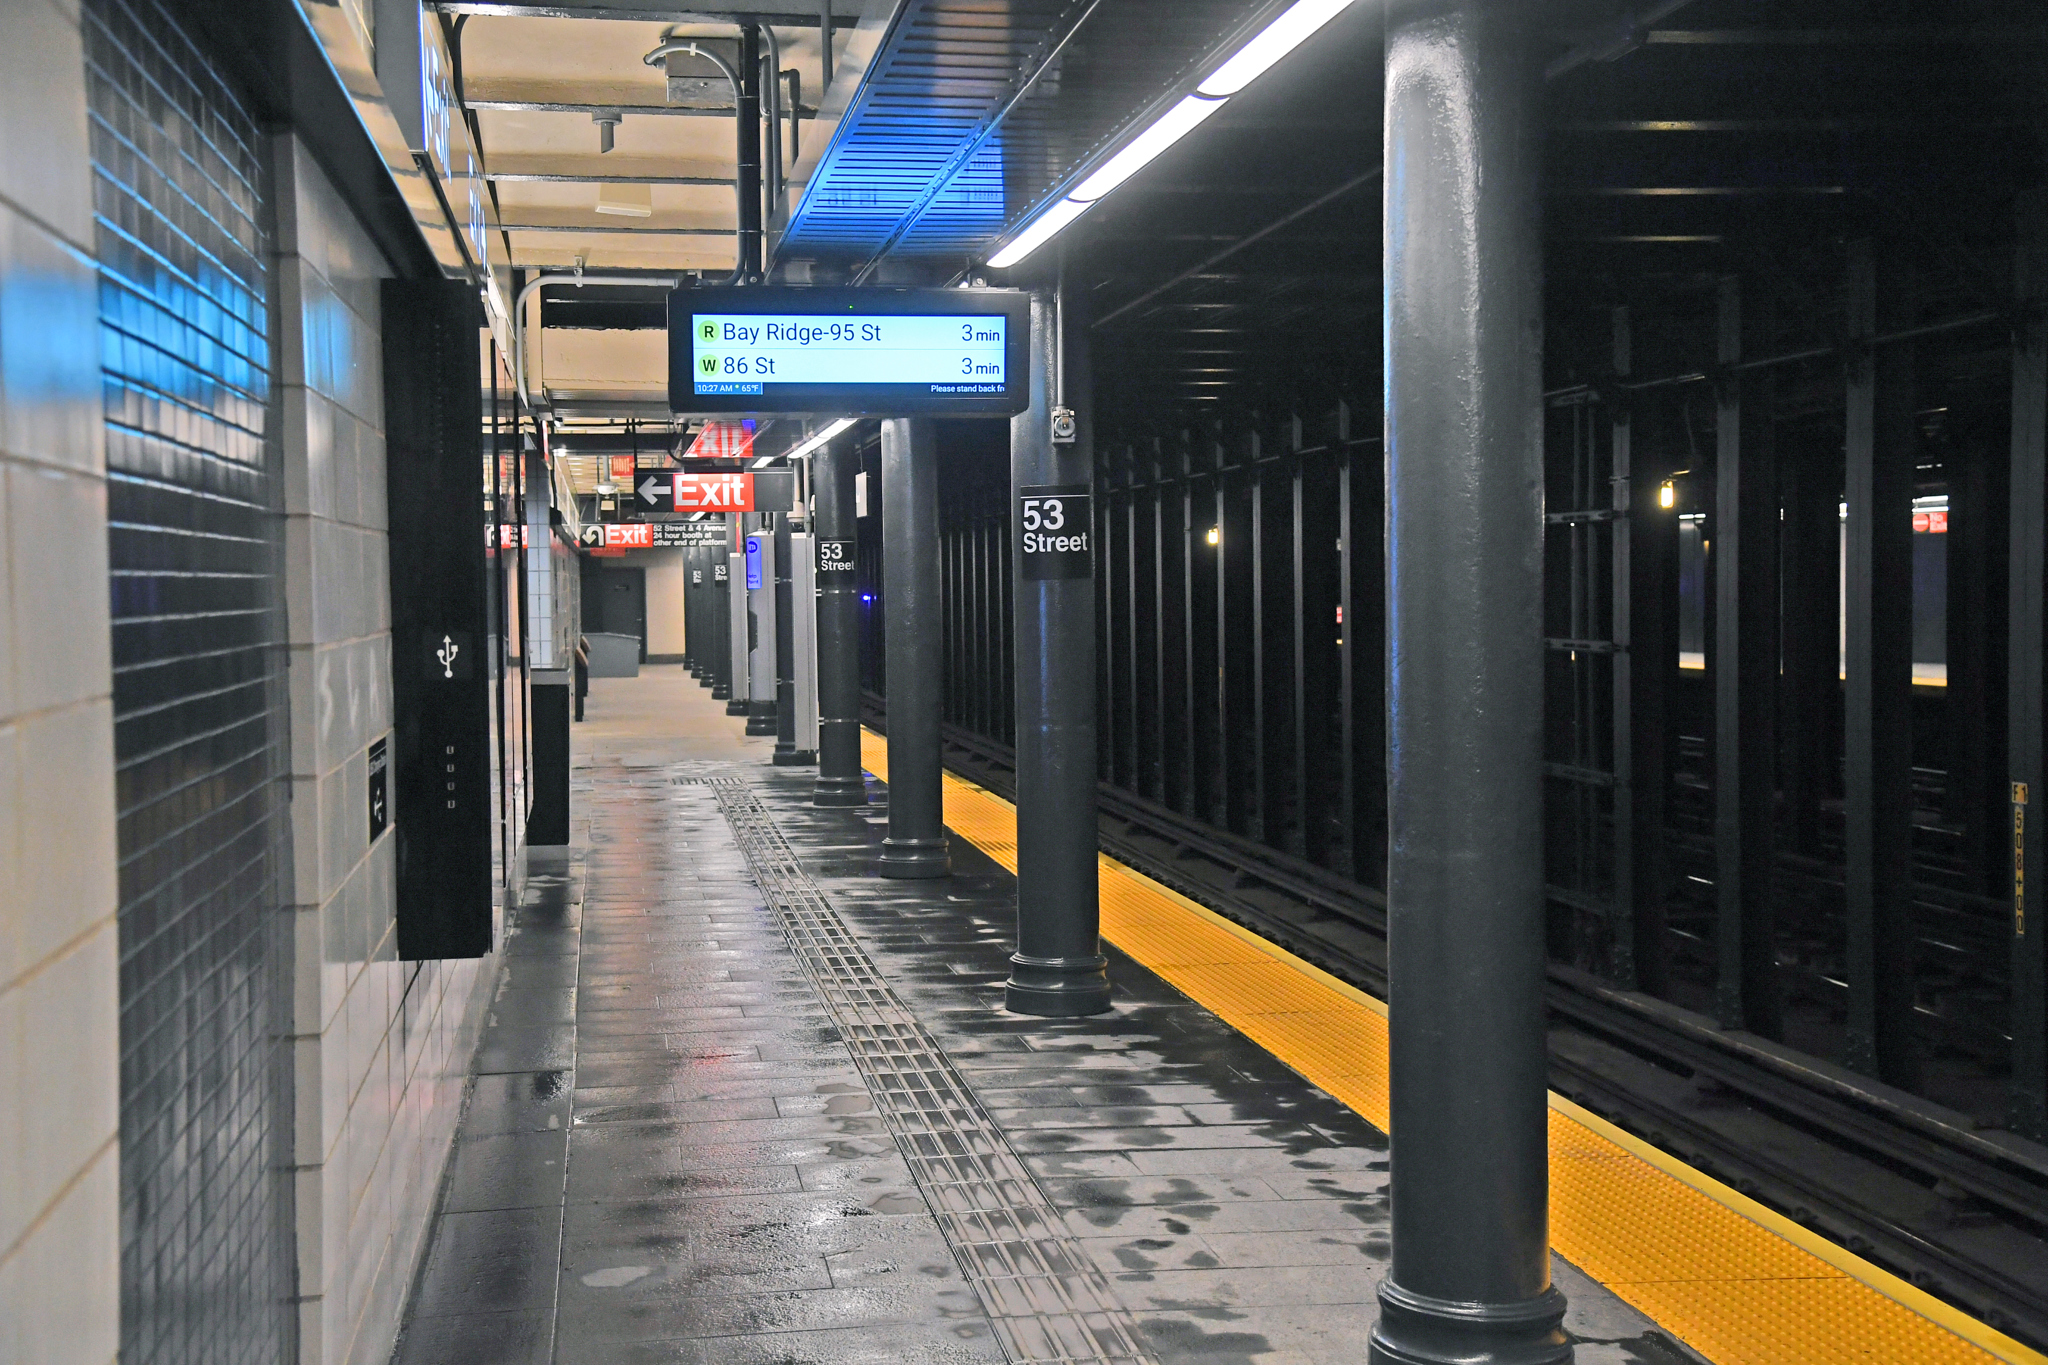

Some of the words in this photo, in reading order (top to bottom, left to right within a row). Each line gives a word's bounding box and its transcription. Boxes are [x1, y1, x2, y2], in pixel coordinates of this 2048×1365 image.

[704, 325, 714, 338] R
[723, 323, 760, 345] Bay
[767, 323, 855, 345] Ridge-95
[861, 323, 881, 341] St
[961, 323, 973, 341] 3
[976, 329, 1000, 341] min
[702, 359, 716, 372] W
[723, 356, 748, 374] 86
[755, 356, 776, 374] St
[961, 357, 973, 374] 3
[976, 362, 1000, 374] min
[697, 384, 718, 392] 10:27
[719, 384, 733, 392] AM
[930, 384, 956, 393] Please
[956, 384, 977, 393] stand
[978, 384, 996, 393] back
[675, 474, 745, 506] Exit
[1023, 499, 1064, 531] 53
[606, 525, 648, 545] Exit
[1023, 532, 1088, 553] Street
[821, 543, 843, 559] 53
[714, 565, 727, 575] 53
[821, 560, 855, 571] Street
